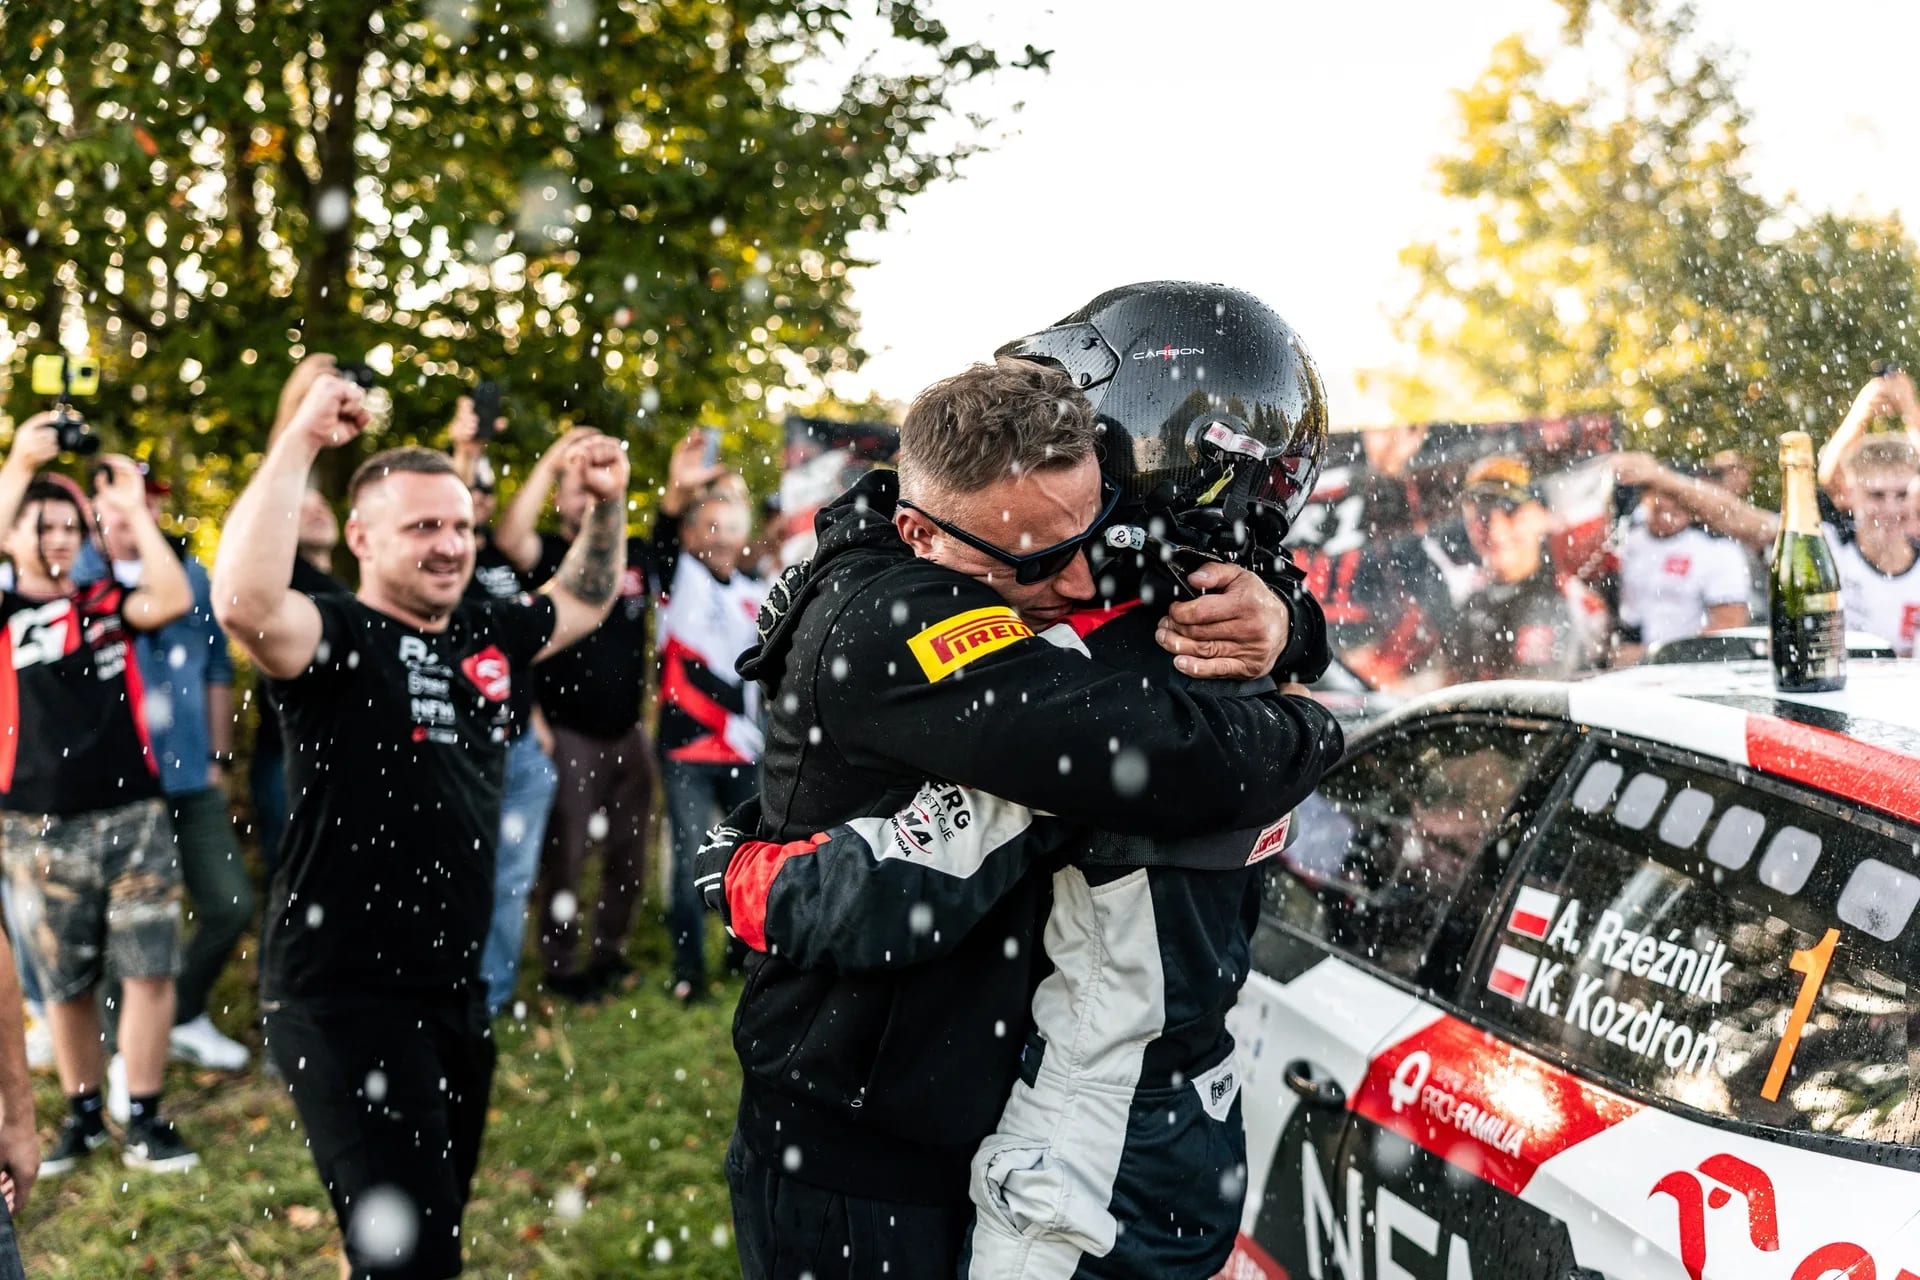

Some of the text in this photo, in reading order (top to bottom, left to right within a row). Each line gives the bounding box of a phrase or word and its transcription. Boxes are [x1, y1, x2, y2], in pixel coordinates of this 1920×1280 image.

[1132, 347, 1205, 360] CARBON
[1547, 899, 1735, 1004] A. Rzeźnik
[1527, 957, 1722, 1075] K. Kozdroń
[1760, 927, 1841, 1103] 1
[1421, 1084, 1526, 1160] PRO-FAMILIA
